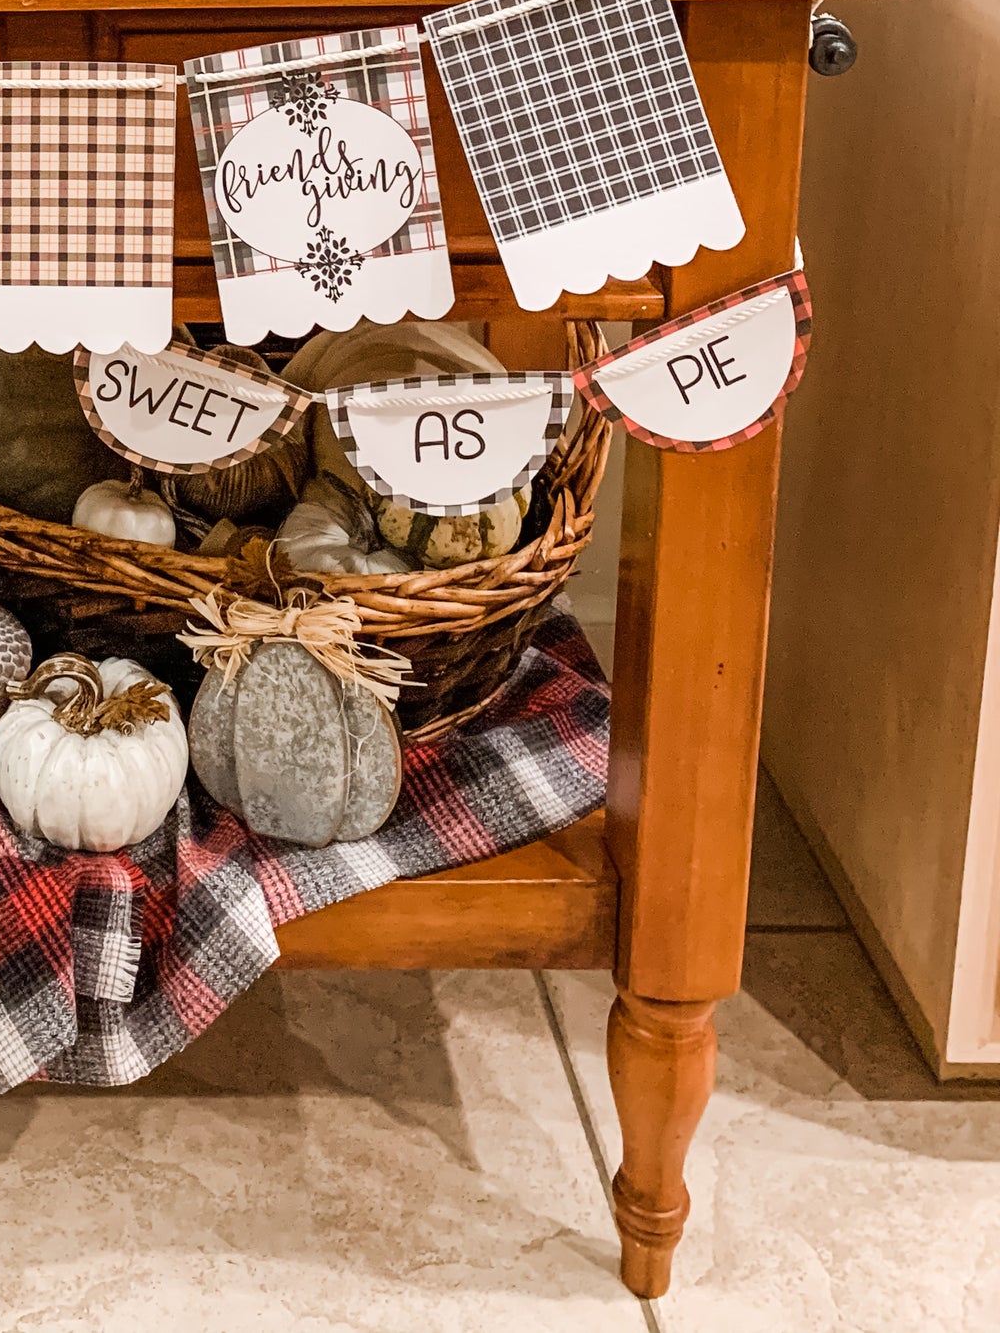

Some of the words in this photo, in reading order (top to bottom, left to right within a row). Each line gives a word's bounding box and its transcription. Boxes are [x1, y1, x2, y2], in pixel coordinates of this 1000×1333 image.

[222, 126, 363, 213] friends
[302, 159, 421, 228] giving
[97, 359, 260, 444] SWEET
[666, 334, 748, 406] PIE
[414, 409, 486, 464] AS
